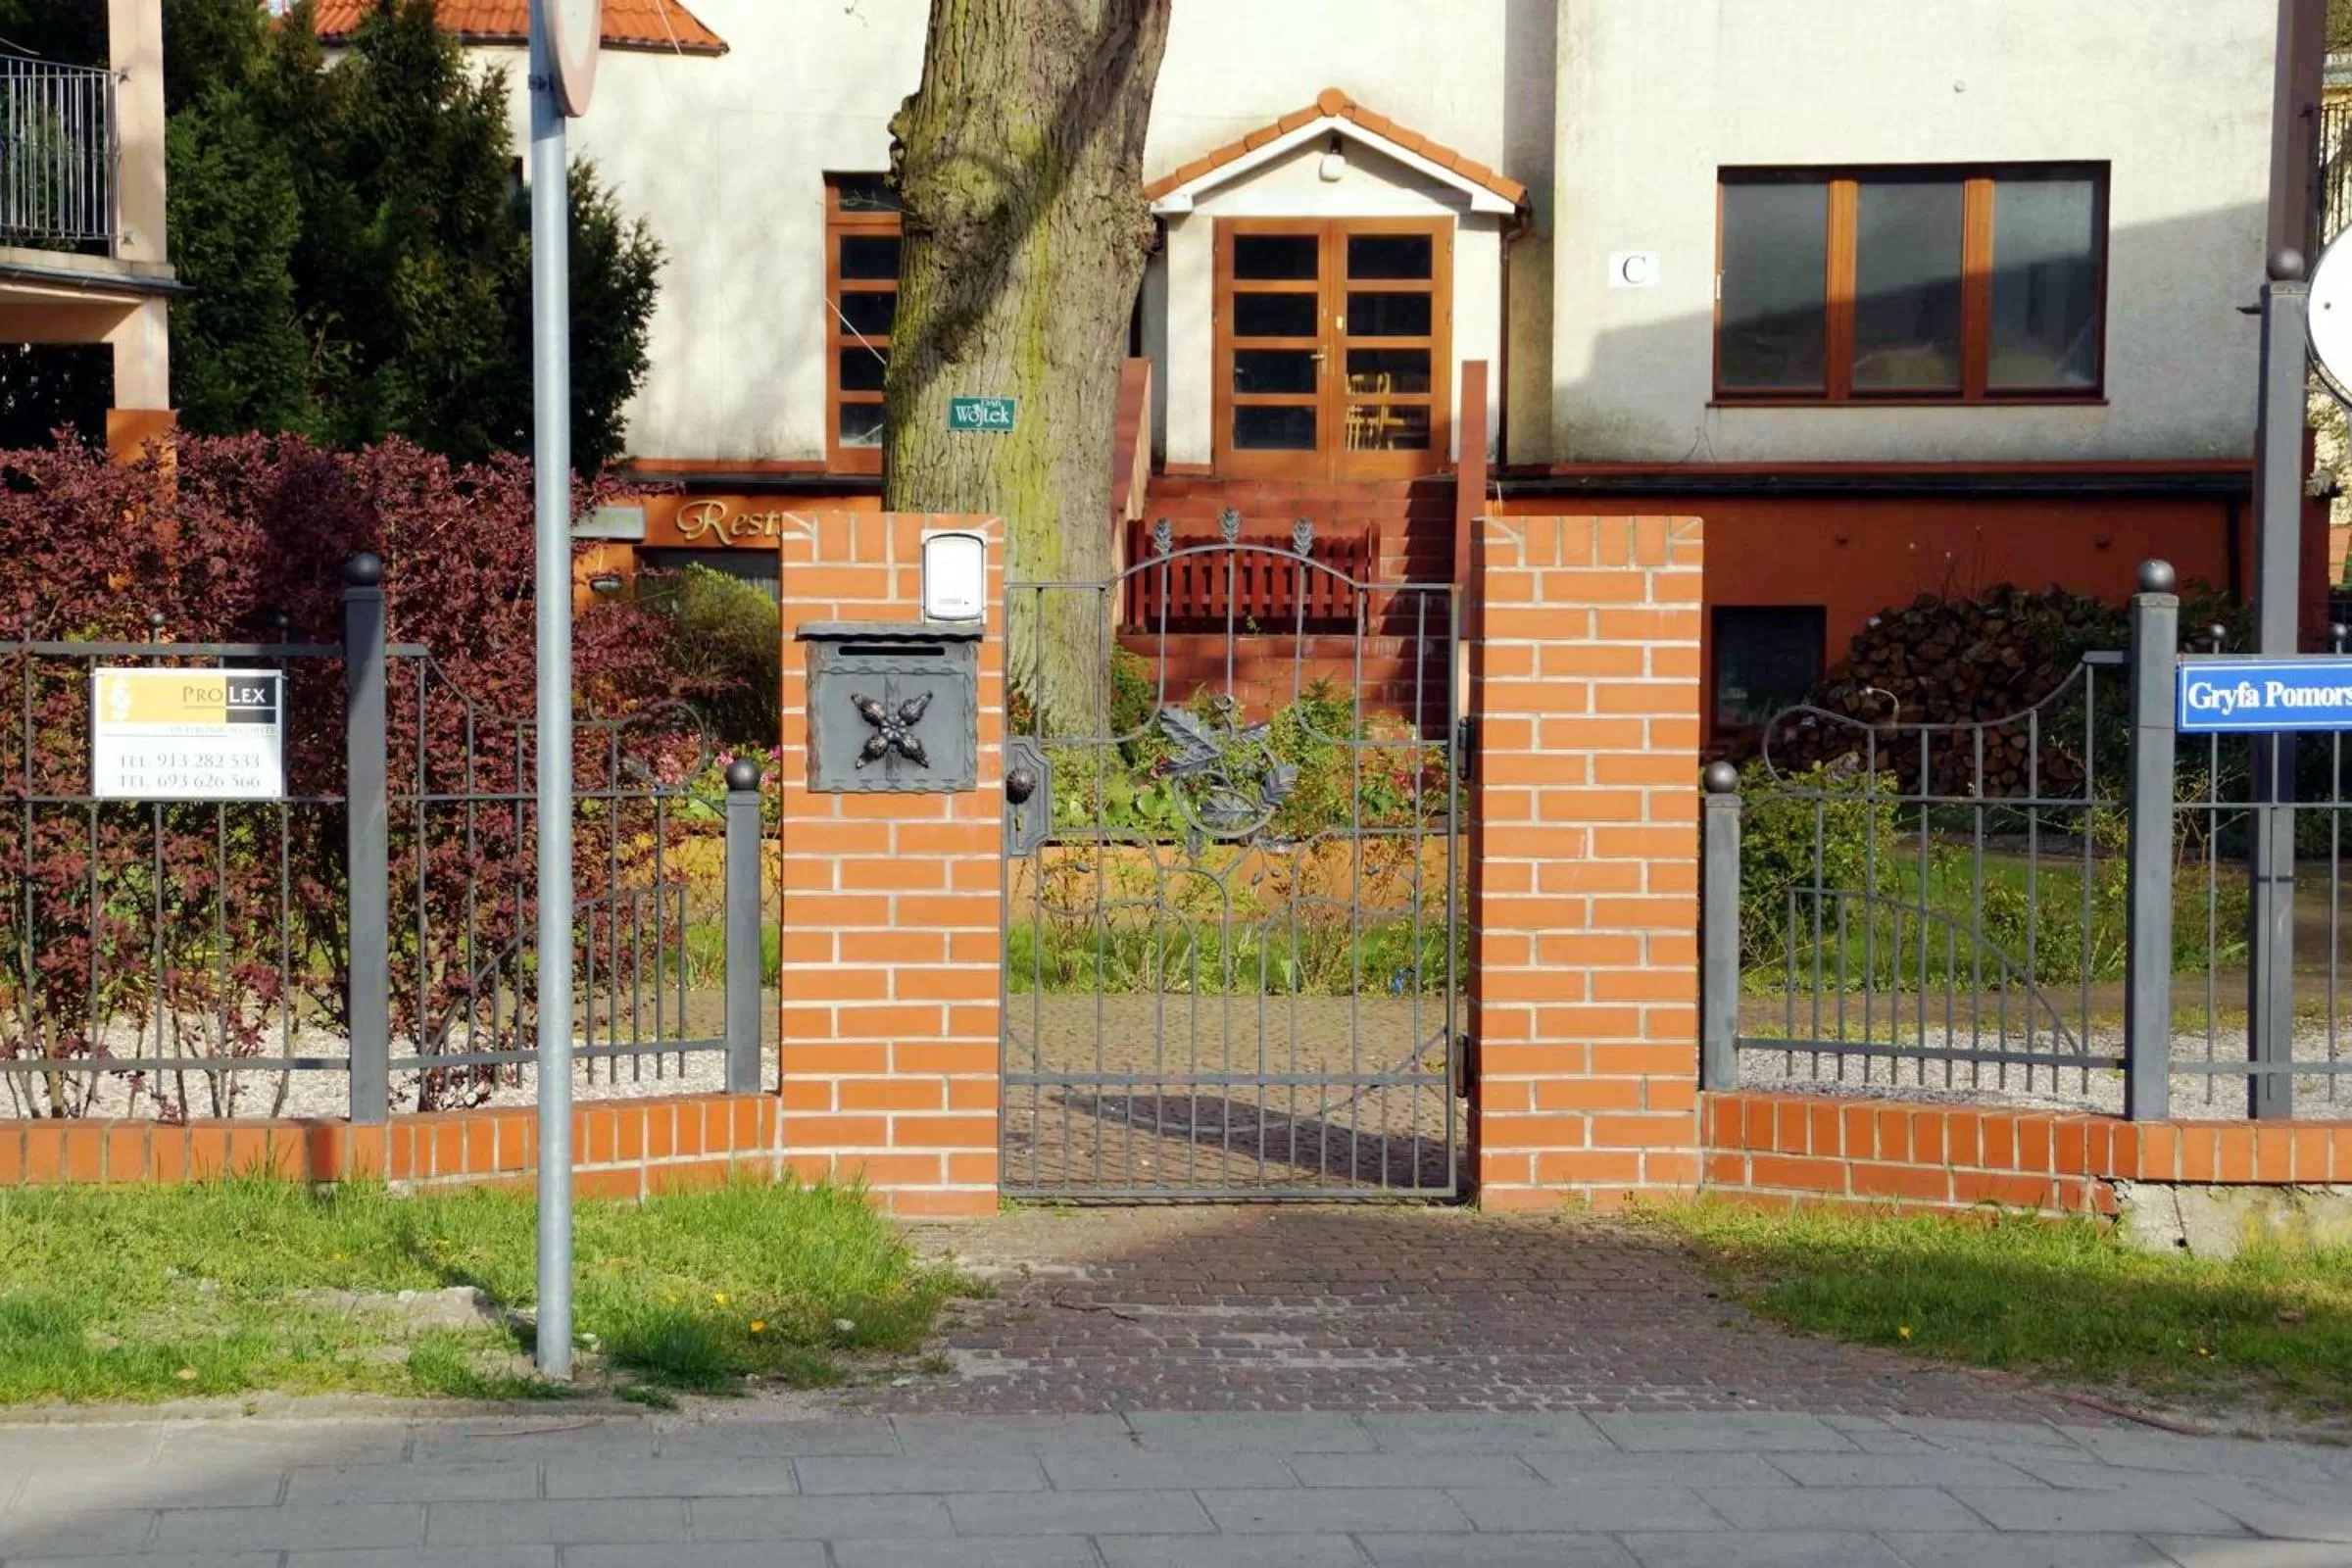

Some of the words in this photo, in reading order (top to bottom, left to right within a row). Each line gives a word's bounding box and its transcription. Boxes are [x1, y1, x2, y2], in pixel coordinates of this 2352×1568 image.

[1622, 255, 1646, 284] C
[2187, 681, 2260, 715] Gryfa
[157, 752, 187, 768] 913
[195, 752, 224, 768] 282
[194, 773, 224, 790] 626
